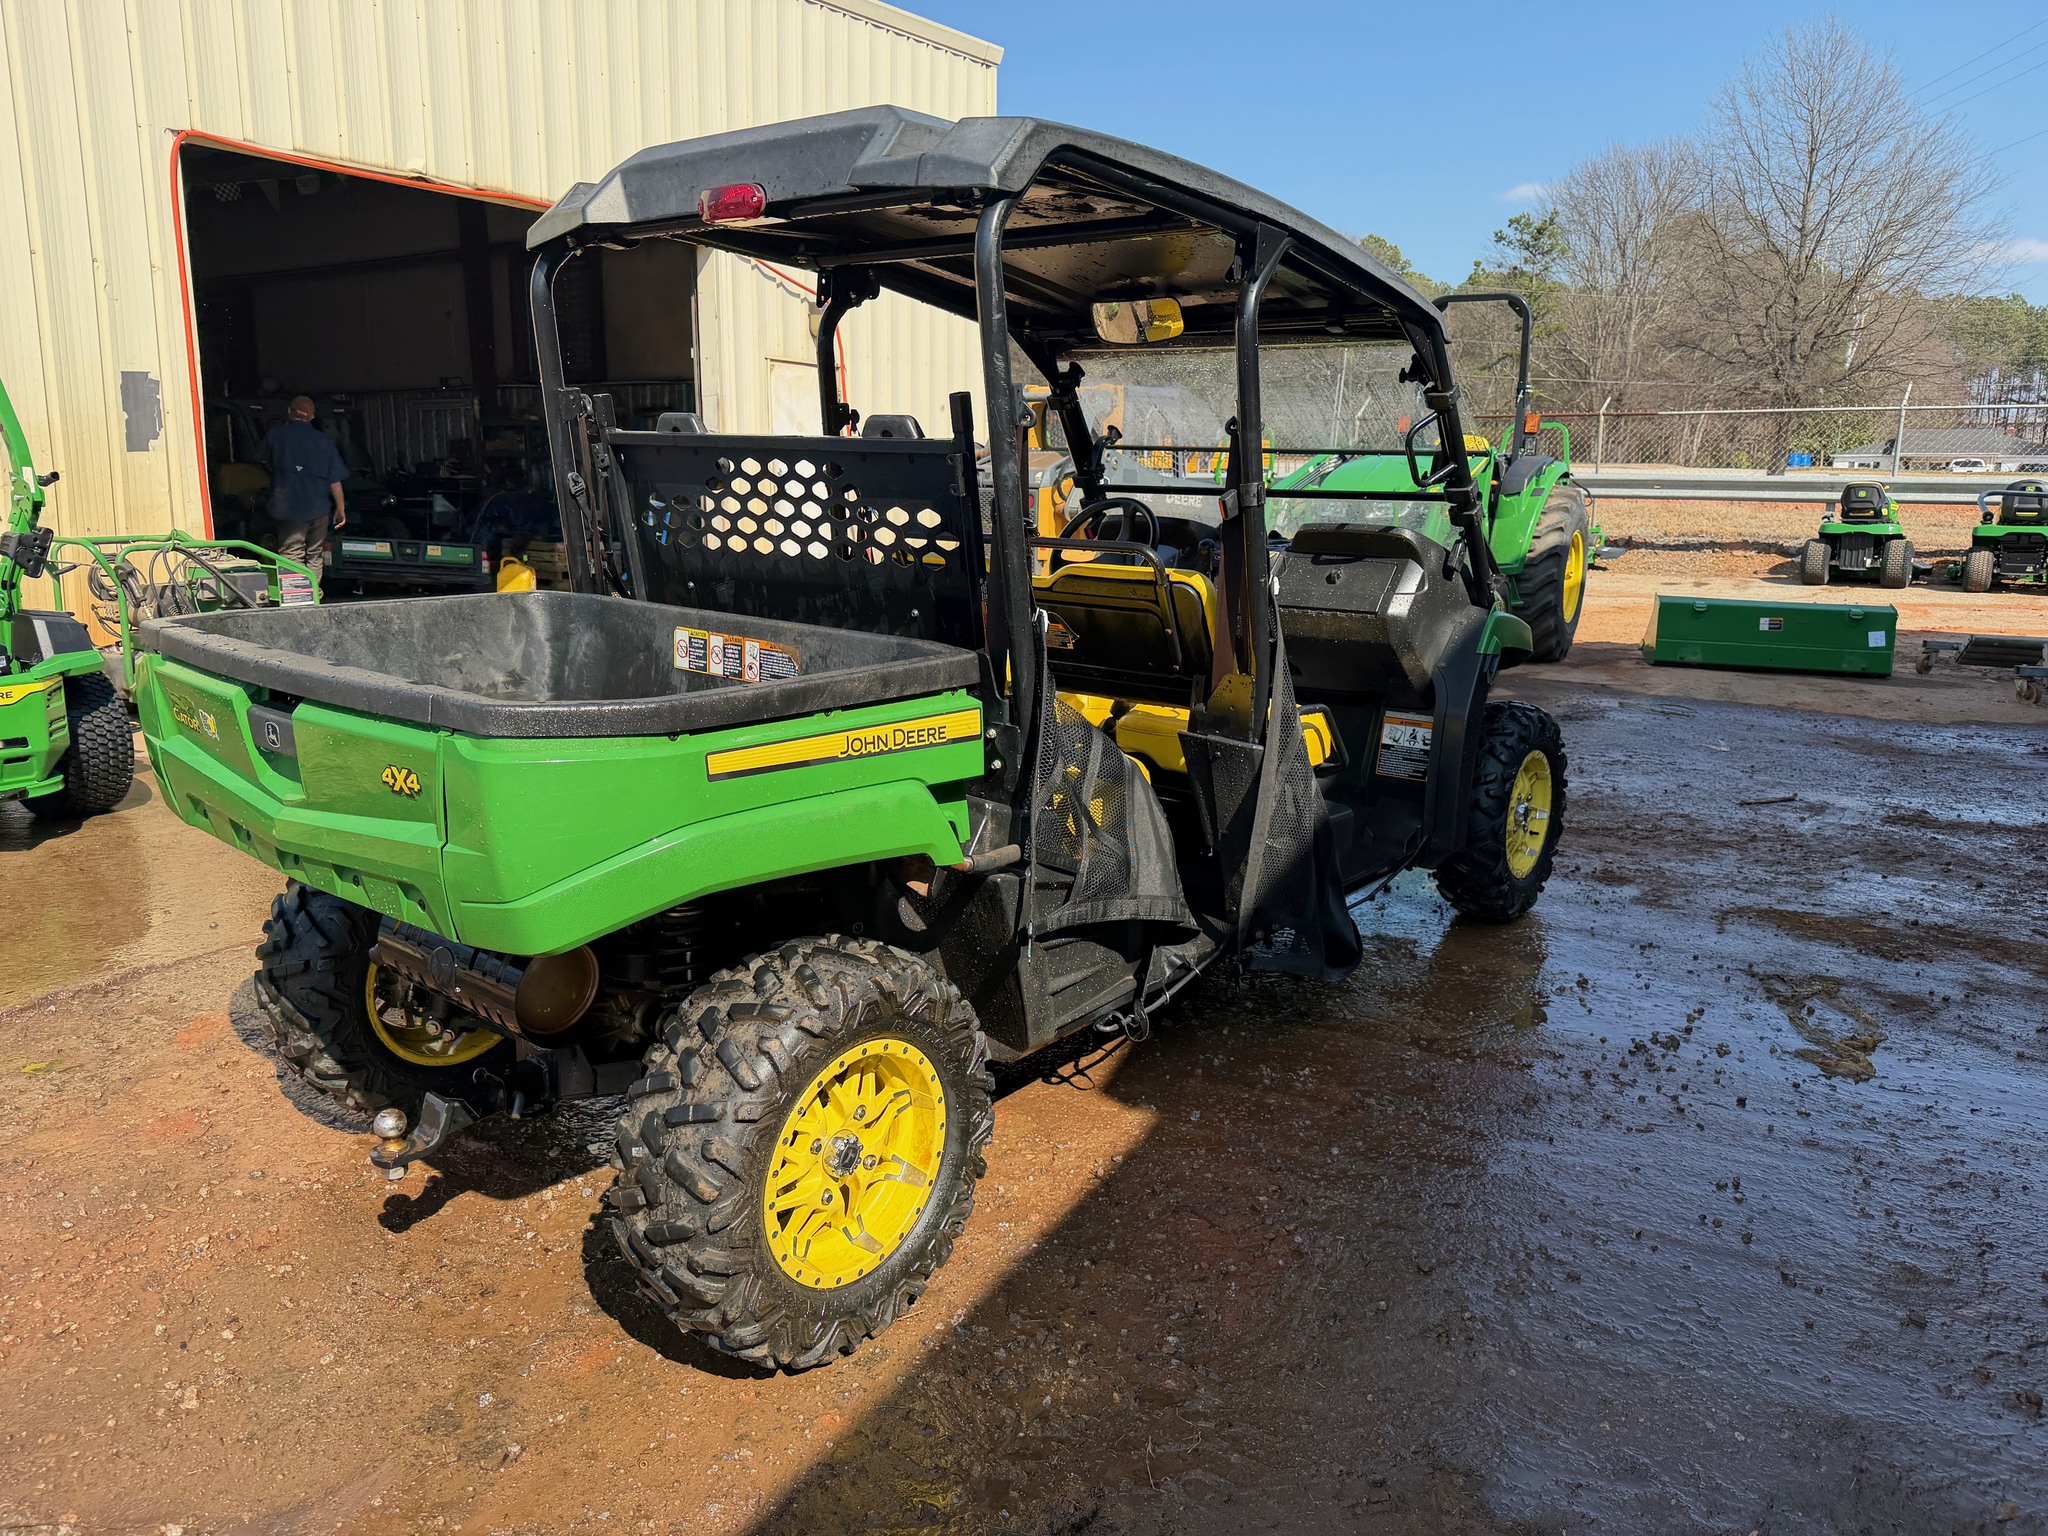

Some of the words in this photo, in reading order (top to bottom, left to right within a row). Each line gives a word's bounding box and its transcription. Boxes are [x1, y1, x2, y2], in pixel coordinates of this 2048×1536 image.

[173, 706, 199, 732] GATOR
[840, 735, 888, 755] JOHN
[893, 725, 947, 747] DEERE
